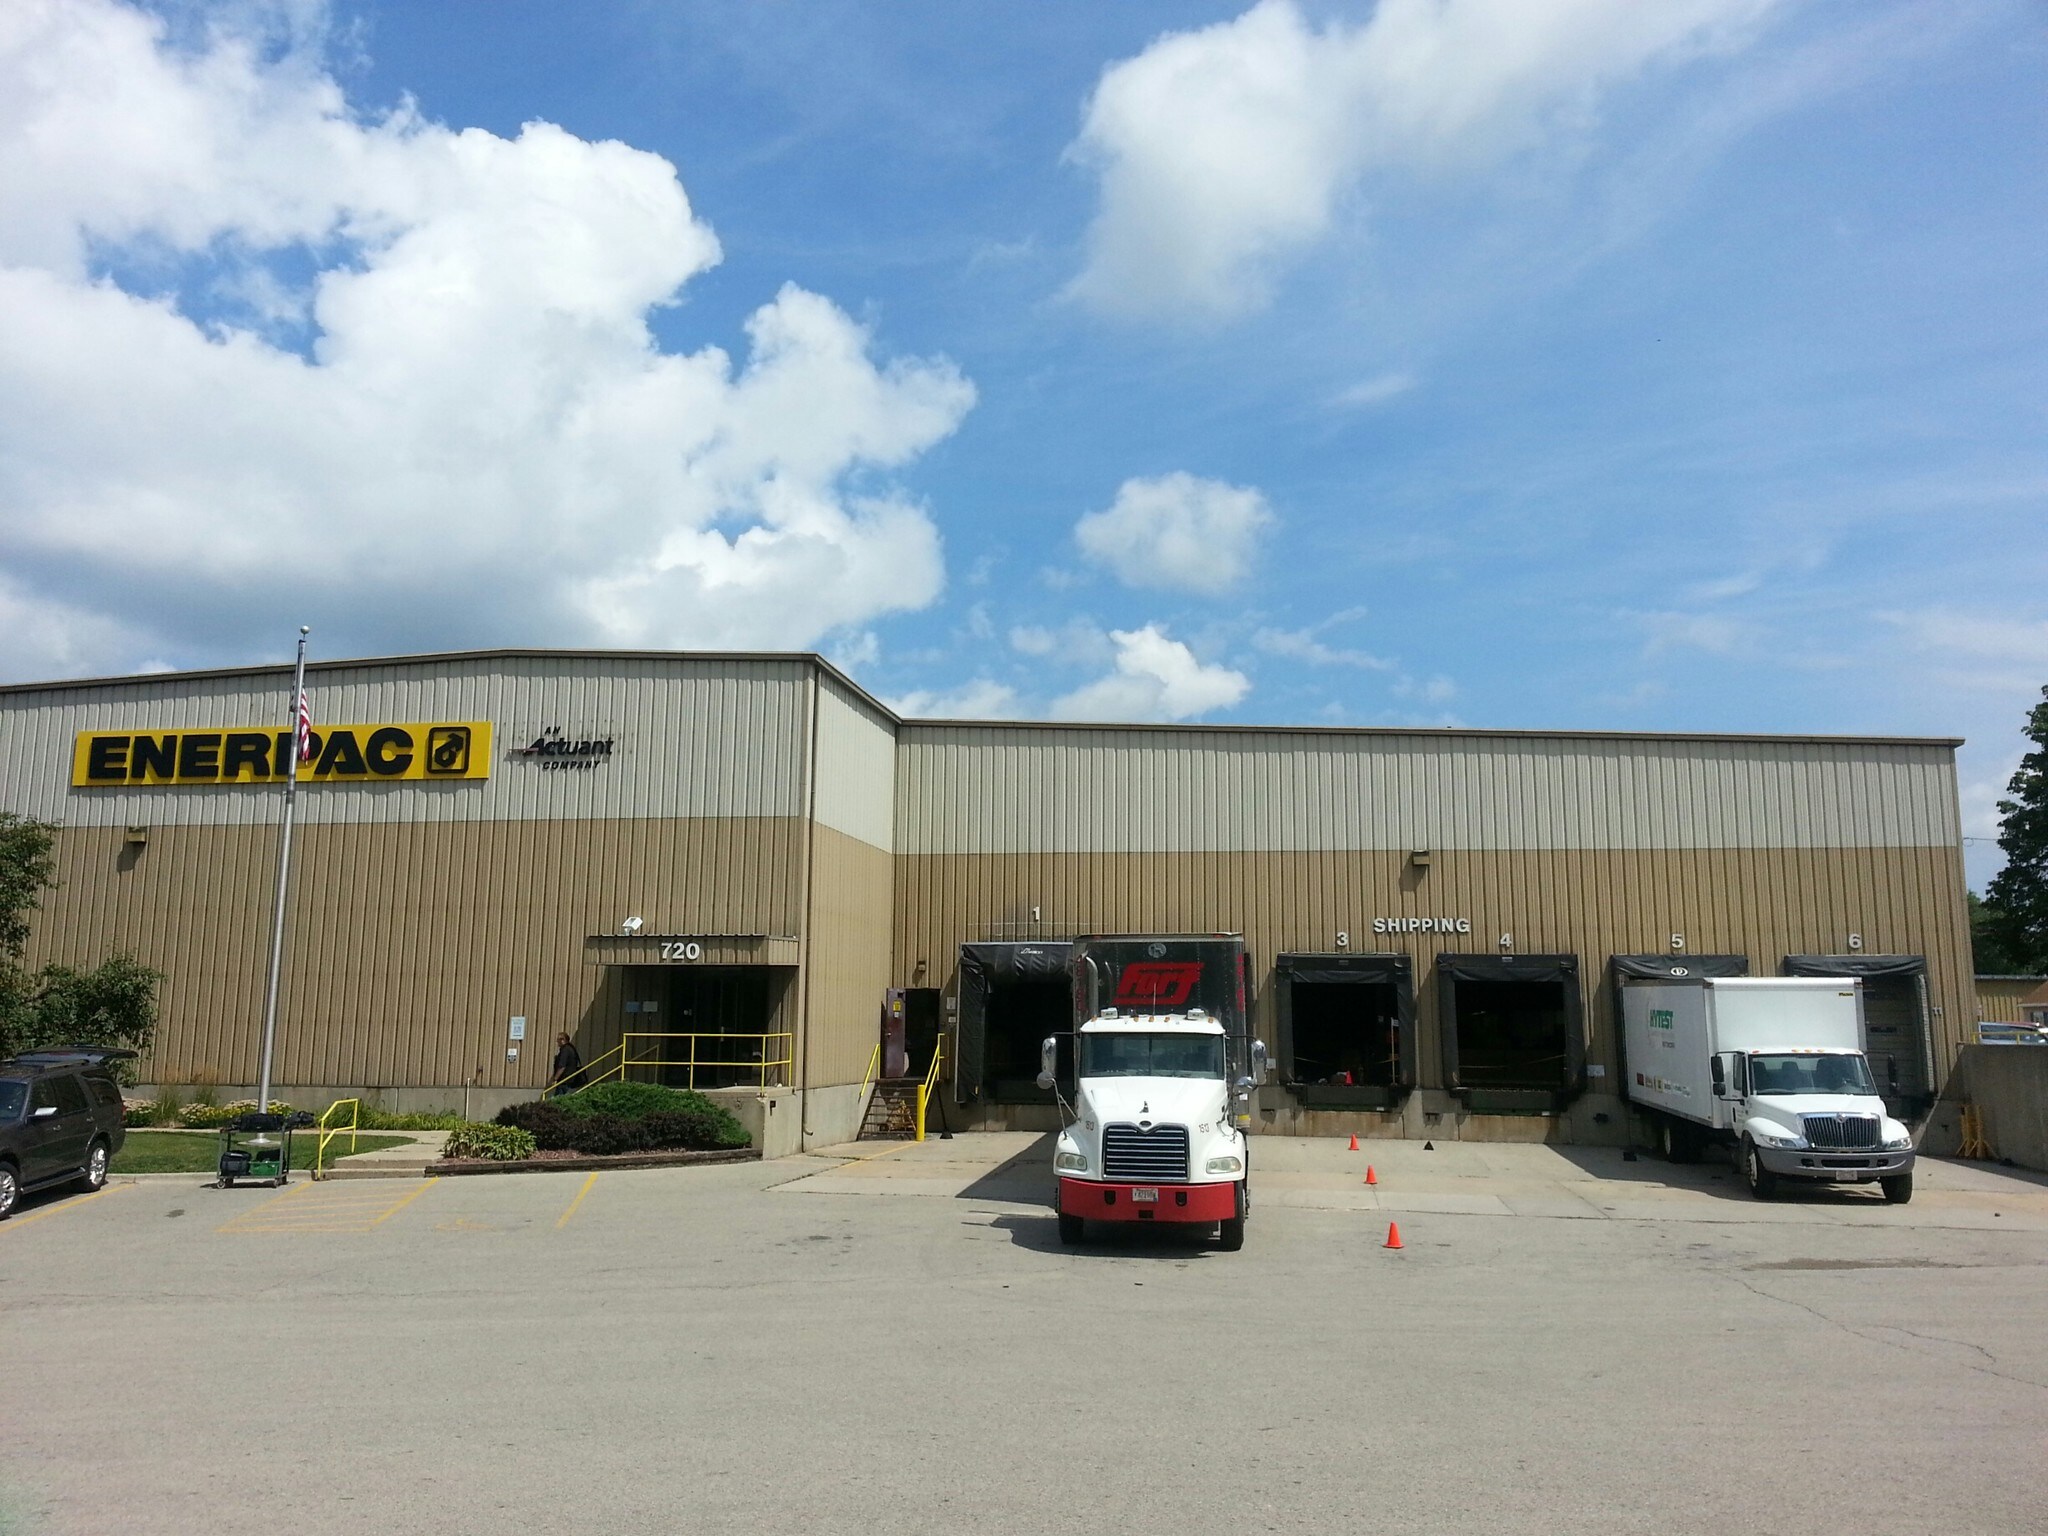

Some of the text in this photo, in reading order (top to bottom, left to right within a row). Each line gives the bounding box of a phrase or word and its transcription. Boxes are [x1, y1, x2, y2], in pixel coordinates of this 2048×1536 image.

[544, 726, 561, 735] AN
[88, 726, 415, 780] ENERPAC
[523, 737, 614, 757] Actuant
[542, 760, 600, 770] COMPANY
[1033, 906, 1041, 921] 1
[1373, 917, 1471, 934] SHIPPING
[1336, 931, 1349, 947] 3
[1499, 933, 1513, 948] 4
[1670, 933, 1685, 948] 5
[1848, 933, 1863, 949] 6
[660, 942, 701, 960] 720
